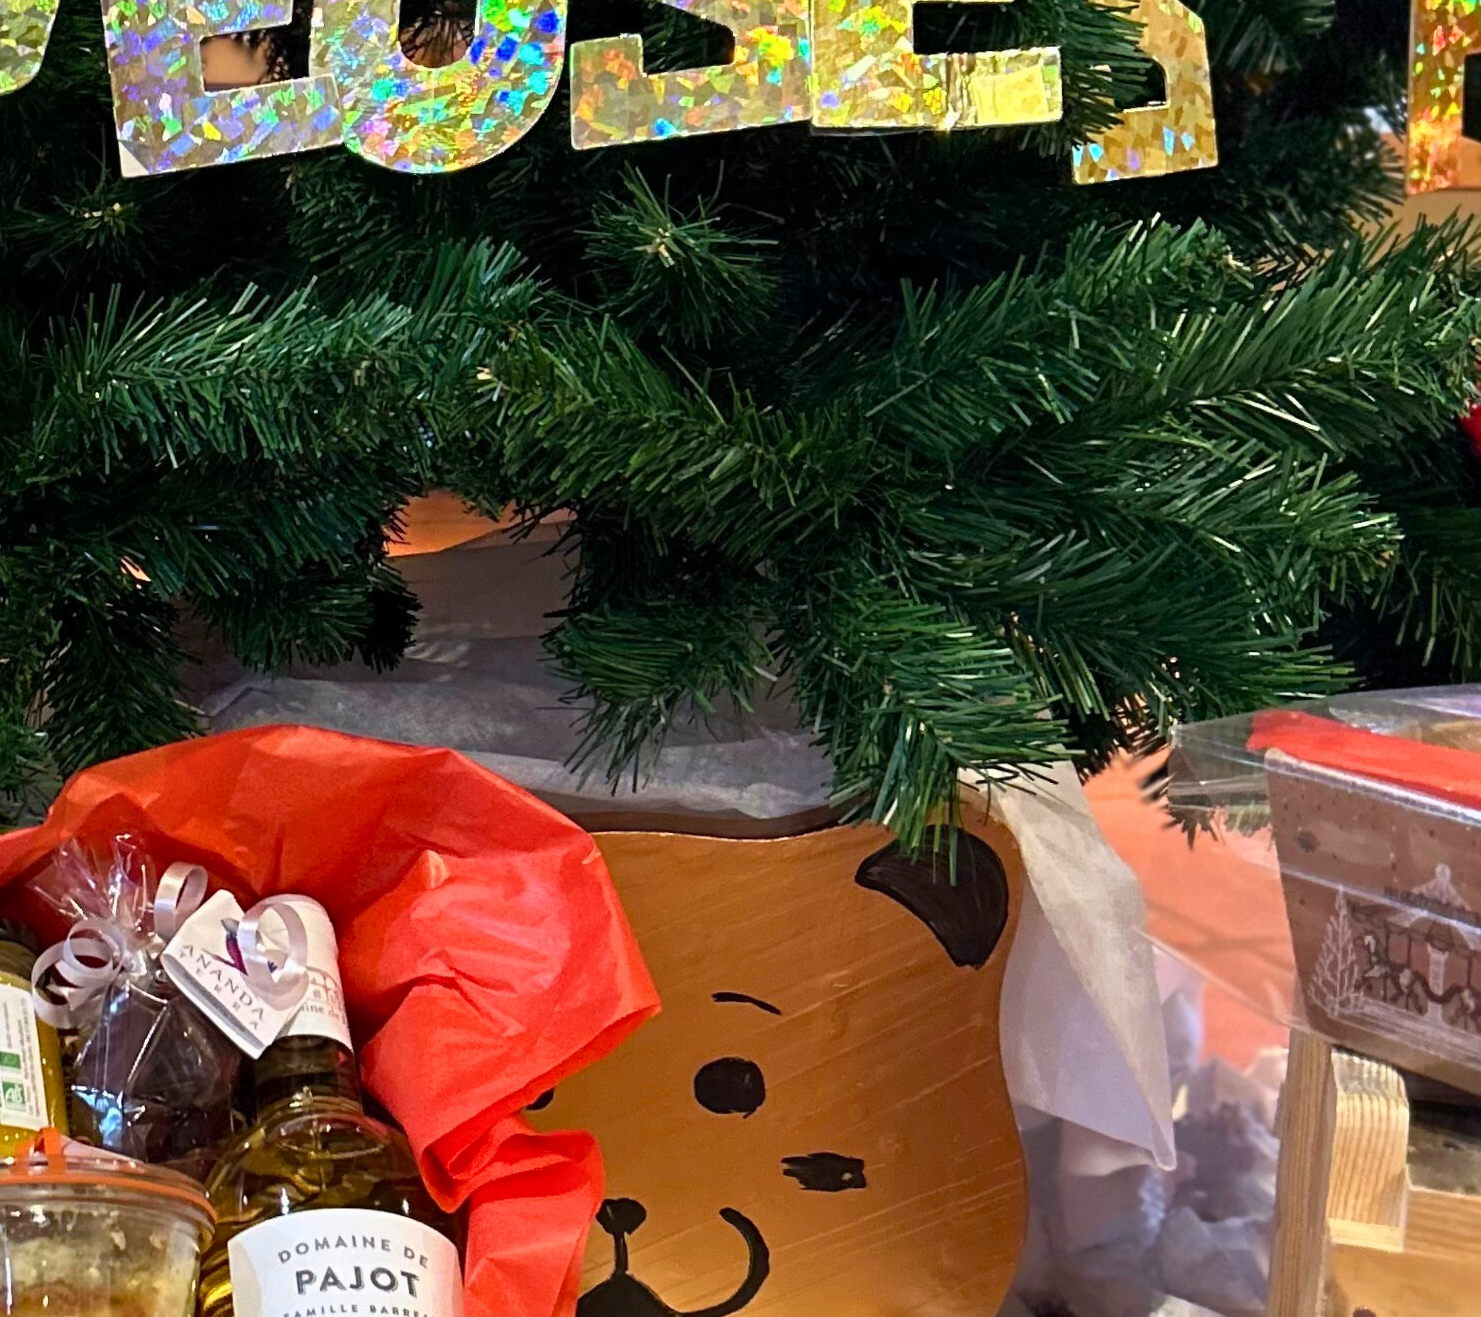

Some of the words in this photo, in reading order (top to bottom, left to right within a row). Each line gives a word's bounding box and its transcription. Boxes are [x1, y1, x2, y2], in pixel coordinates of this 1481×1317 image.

[179, 951, 259, 1031] TERRA
[181, 944, 265, 1021] ANANDA
[278, 1234, 391, 1264] DOMAINE
[403, 1245, 429, 1268] DE
[295, 1265, 420, 1297] PAJOT
